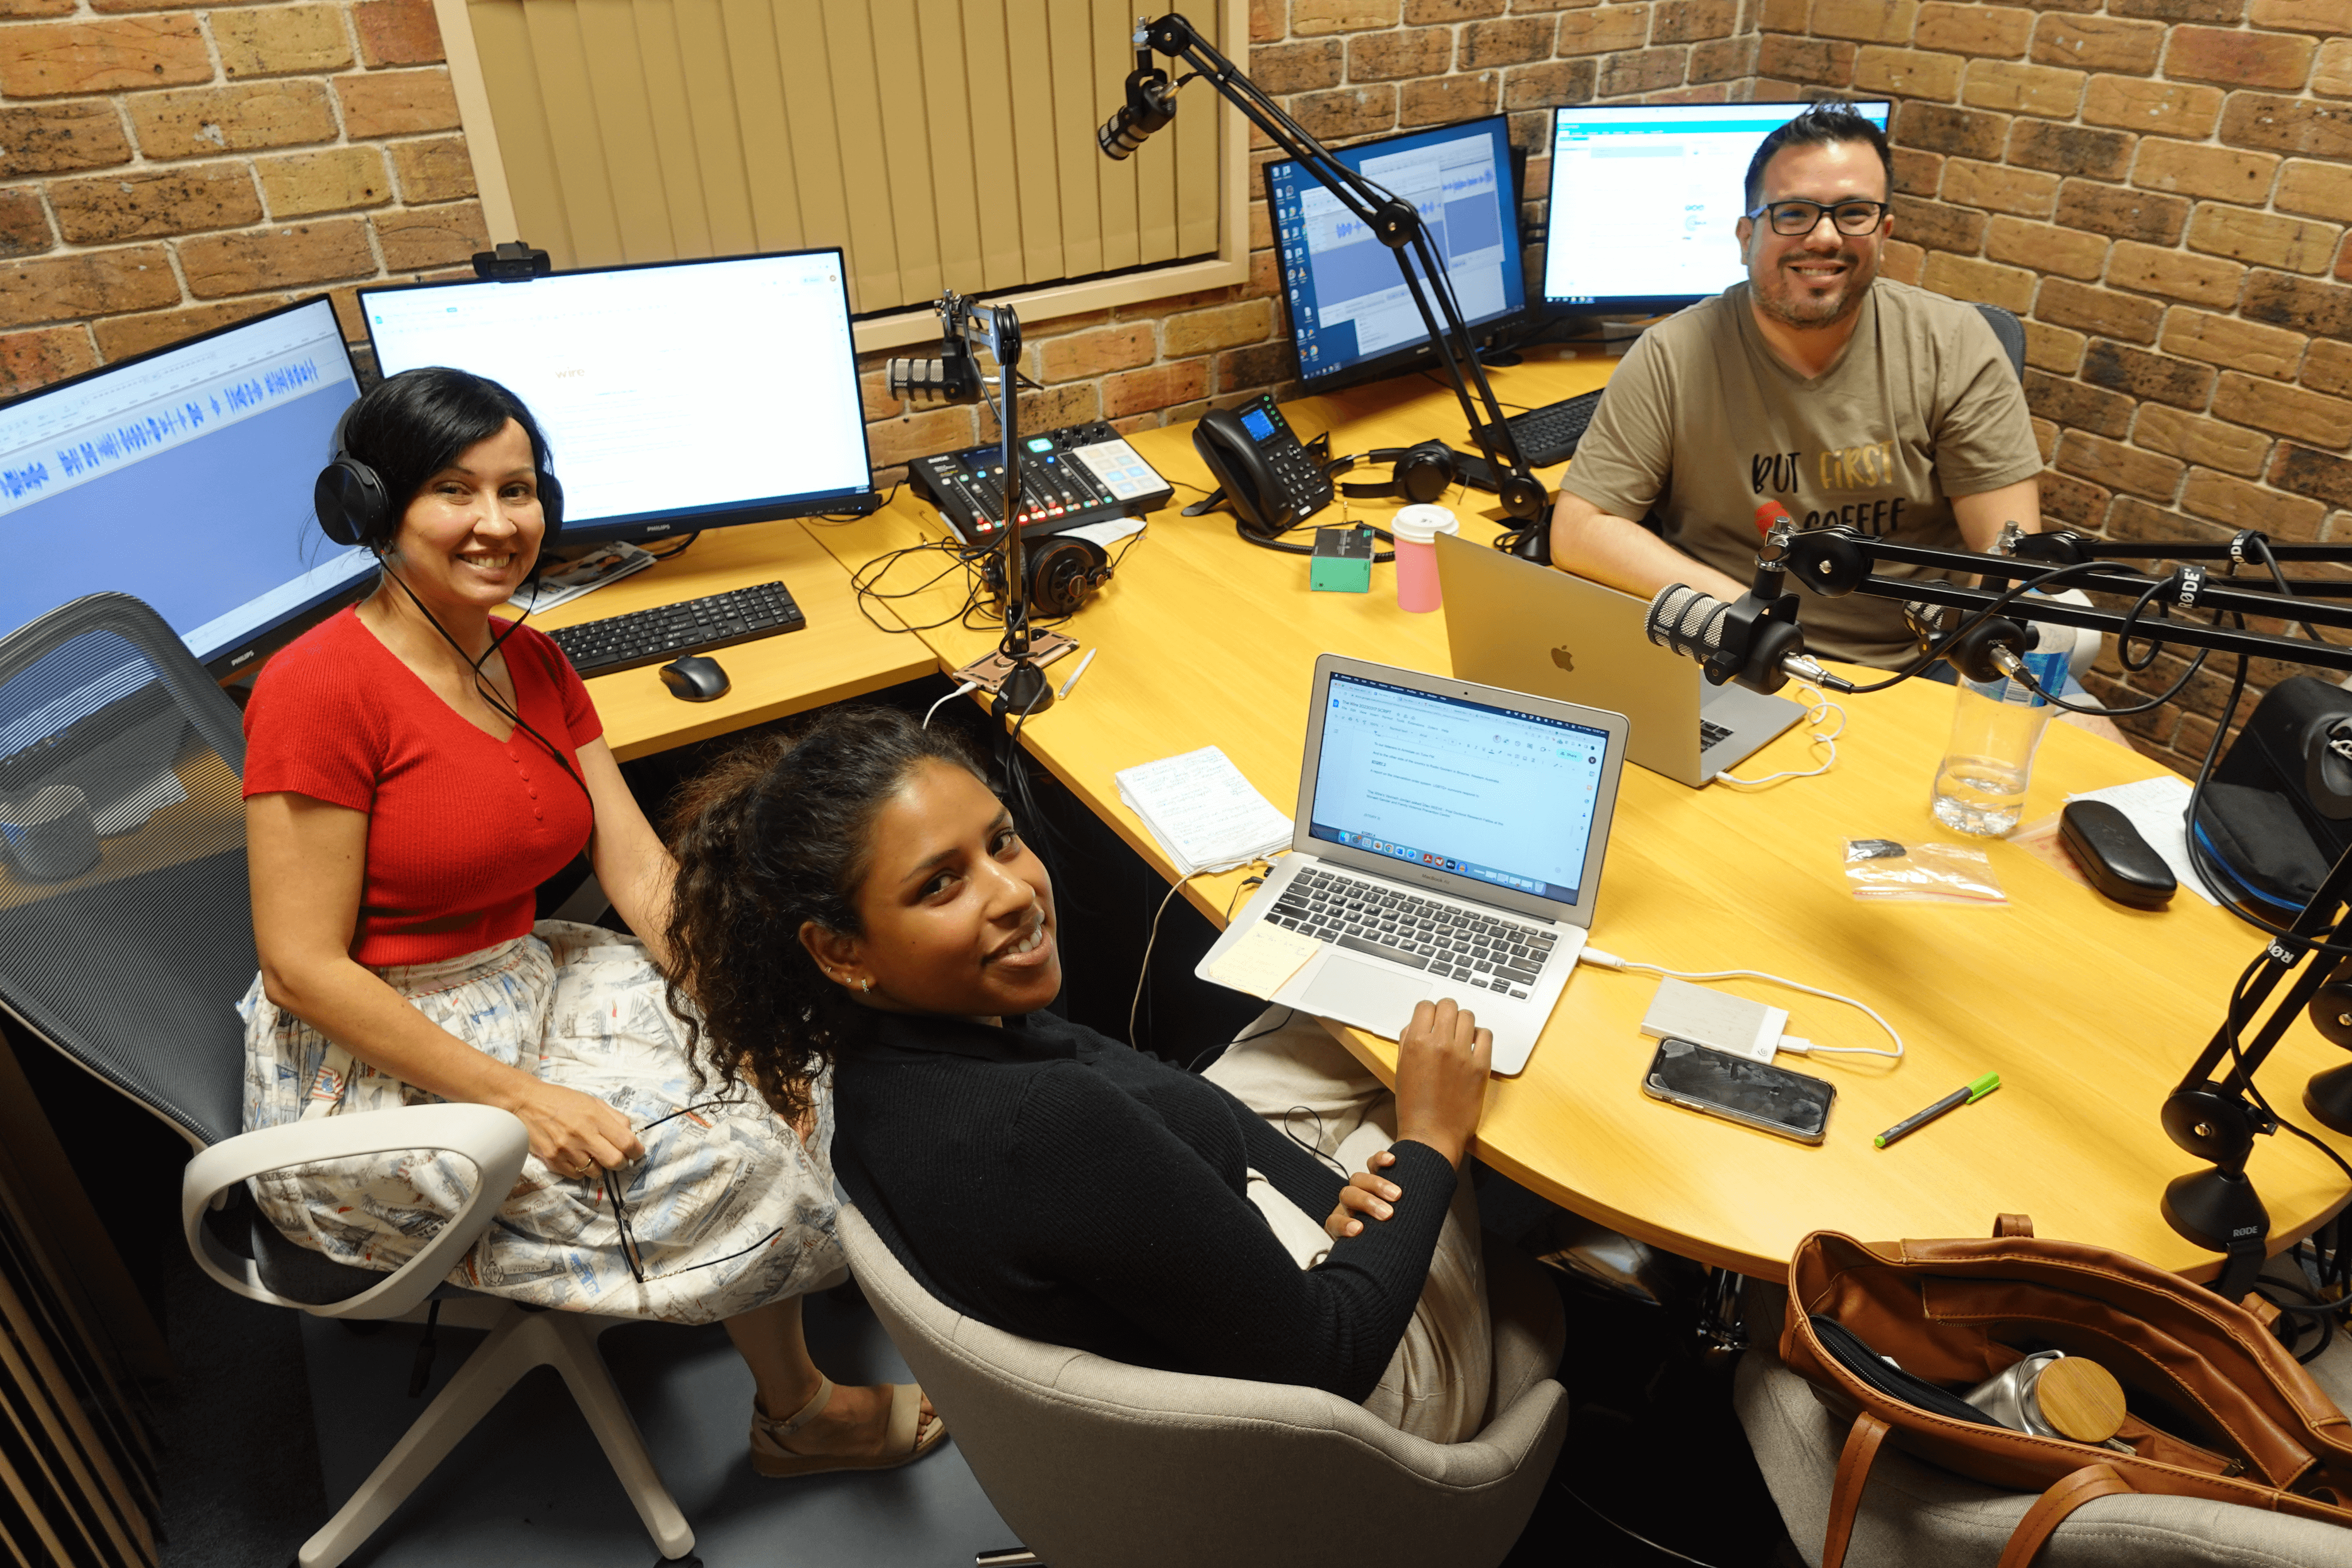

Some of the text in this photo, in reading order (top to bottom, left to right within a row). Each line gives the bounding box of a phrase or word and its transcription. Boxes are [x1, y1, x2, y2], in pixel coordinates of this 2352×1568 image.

[555, 367, 586, 380] wire
[1752, 452, 1801, 494] BUT
[647, 524, 671, 533] PHILIPS
[2230, 538, 2246, 563] ØDE
[1653, 624, 1670, 637] RØDE
[231, 649, 254, 667] PHILIPS
[1422, 873, 1442, 882] MacBook
[2268, 939, 2295, 964] RØ
[2233, 1226, 2258, 1237] RØDE
